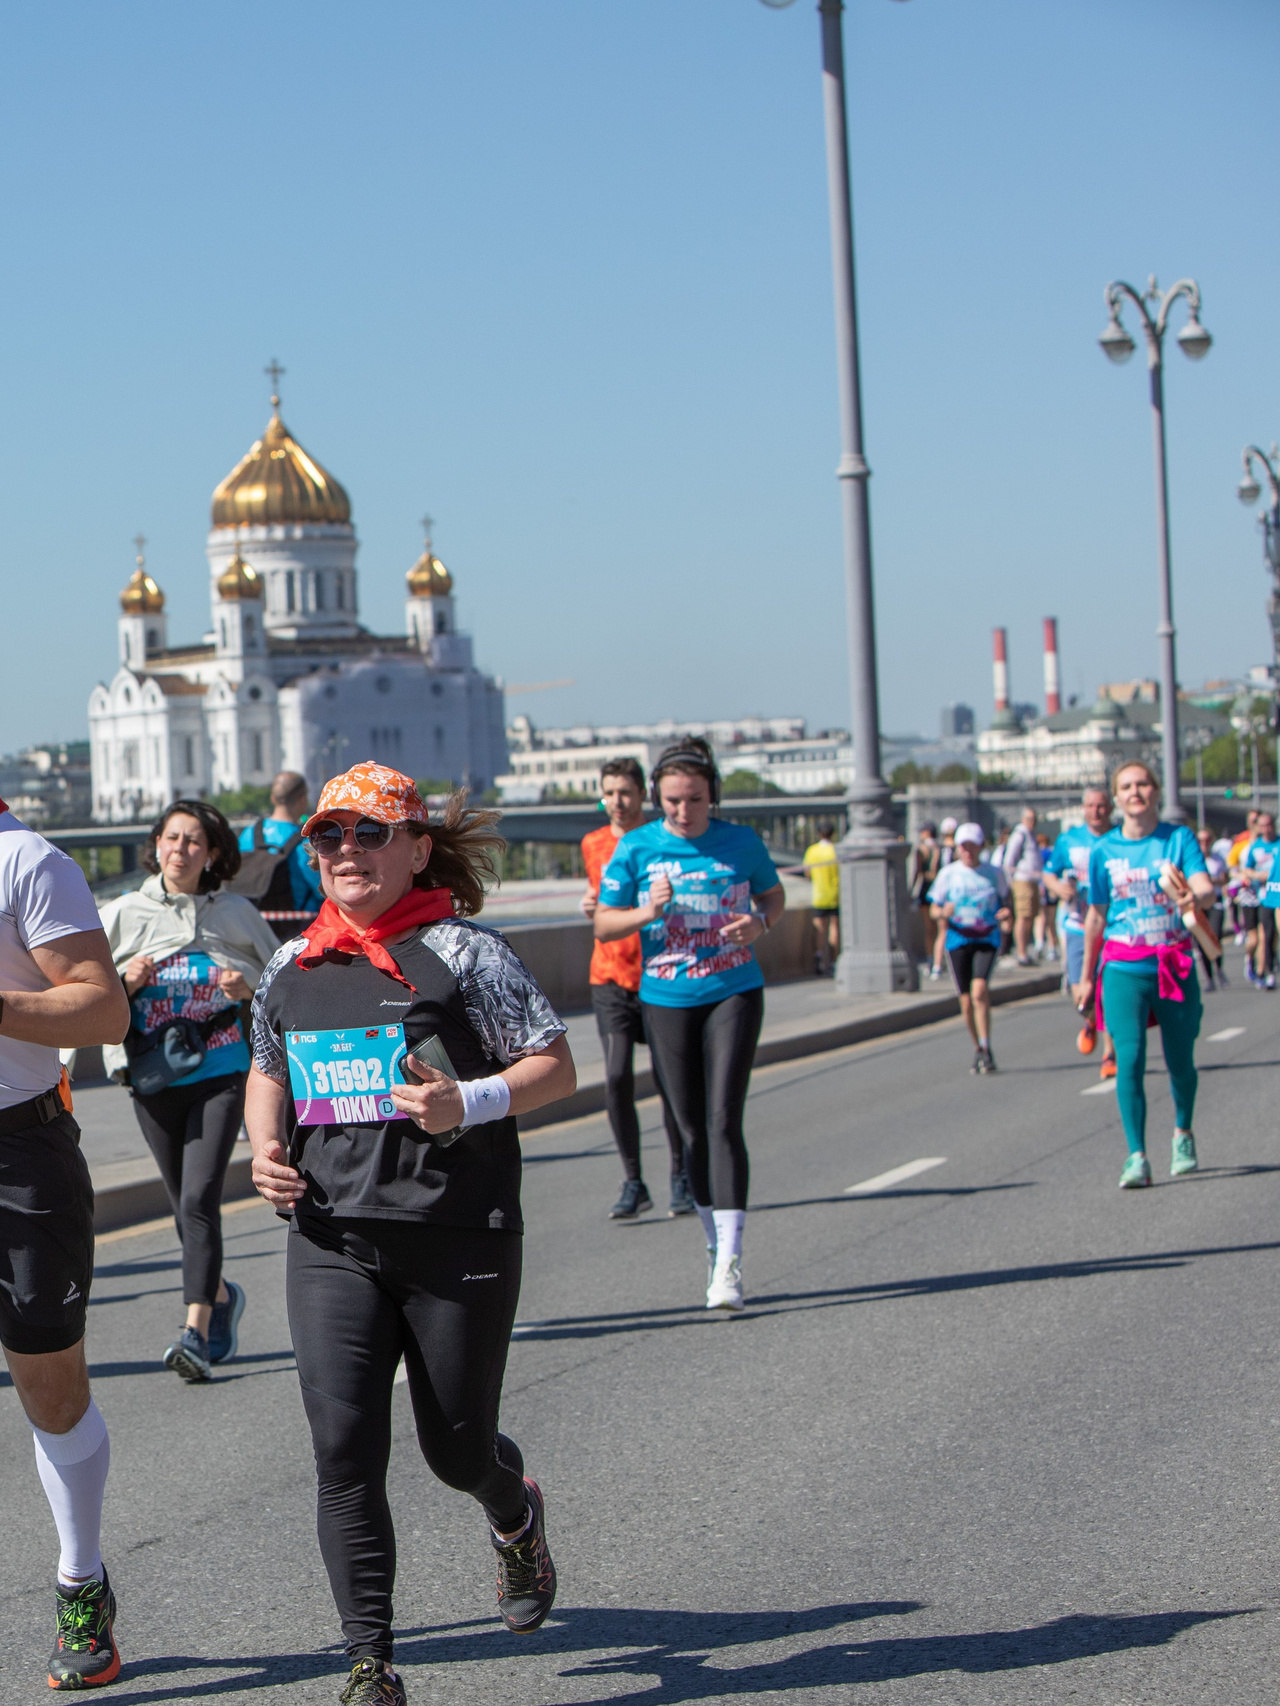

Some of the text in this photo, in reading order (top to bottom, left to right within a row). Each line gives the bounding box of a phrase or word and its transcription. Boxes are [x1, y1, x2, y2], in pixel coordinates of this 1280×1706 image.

[300, 1035, 317, 1043] ПСБ
[312, 1057, 386, 1094] 31592
[382, 1101, 393, 1113] D
